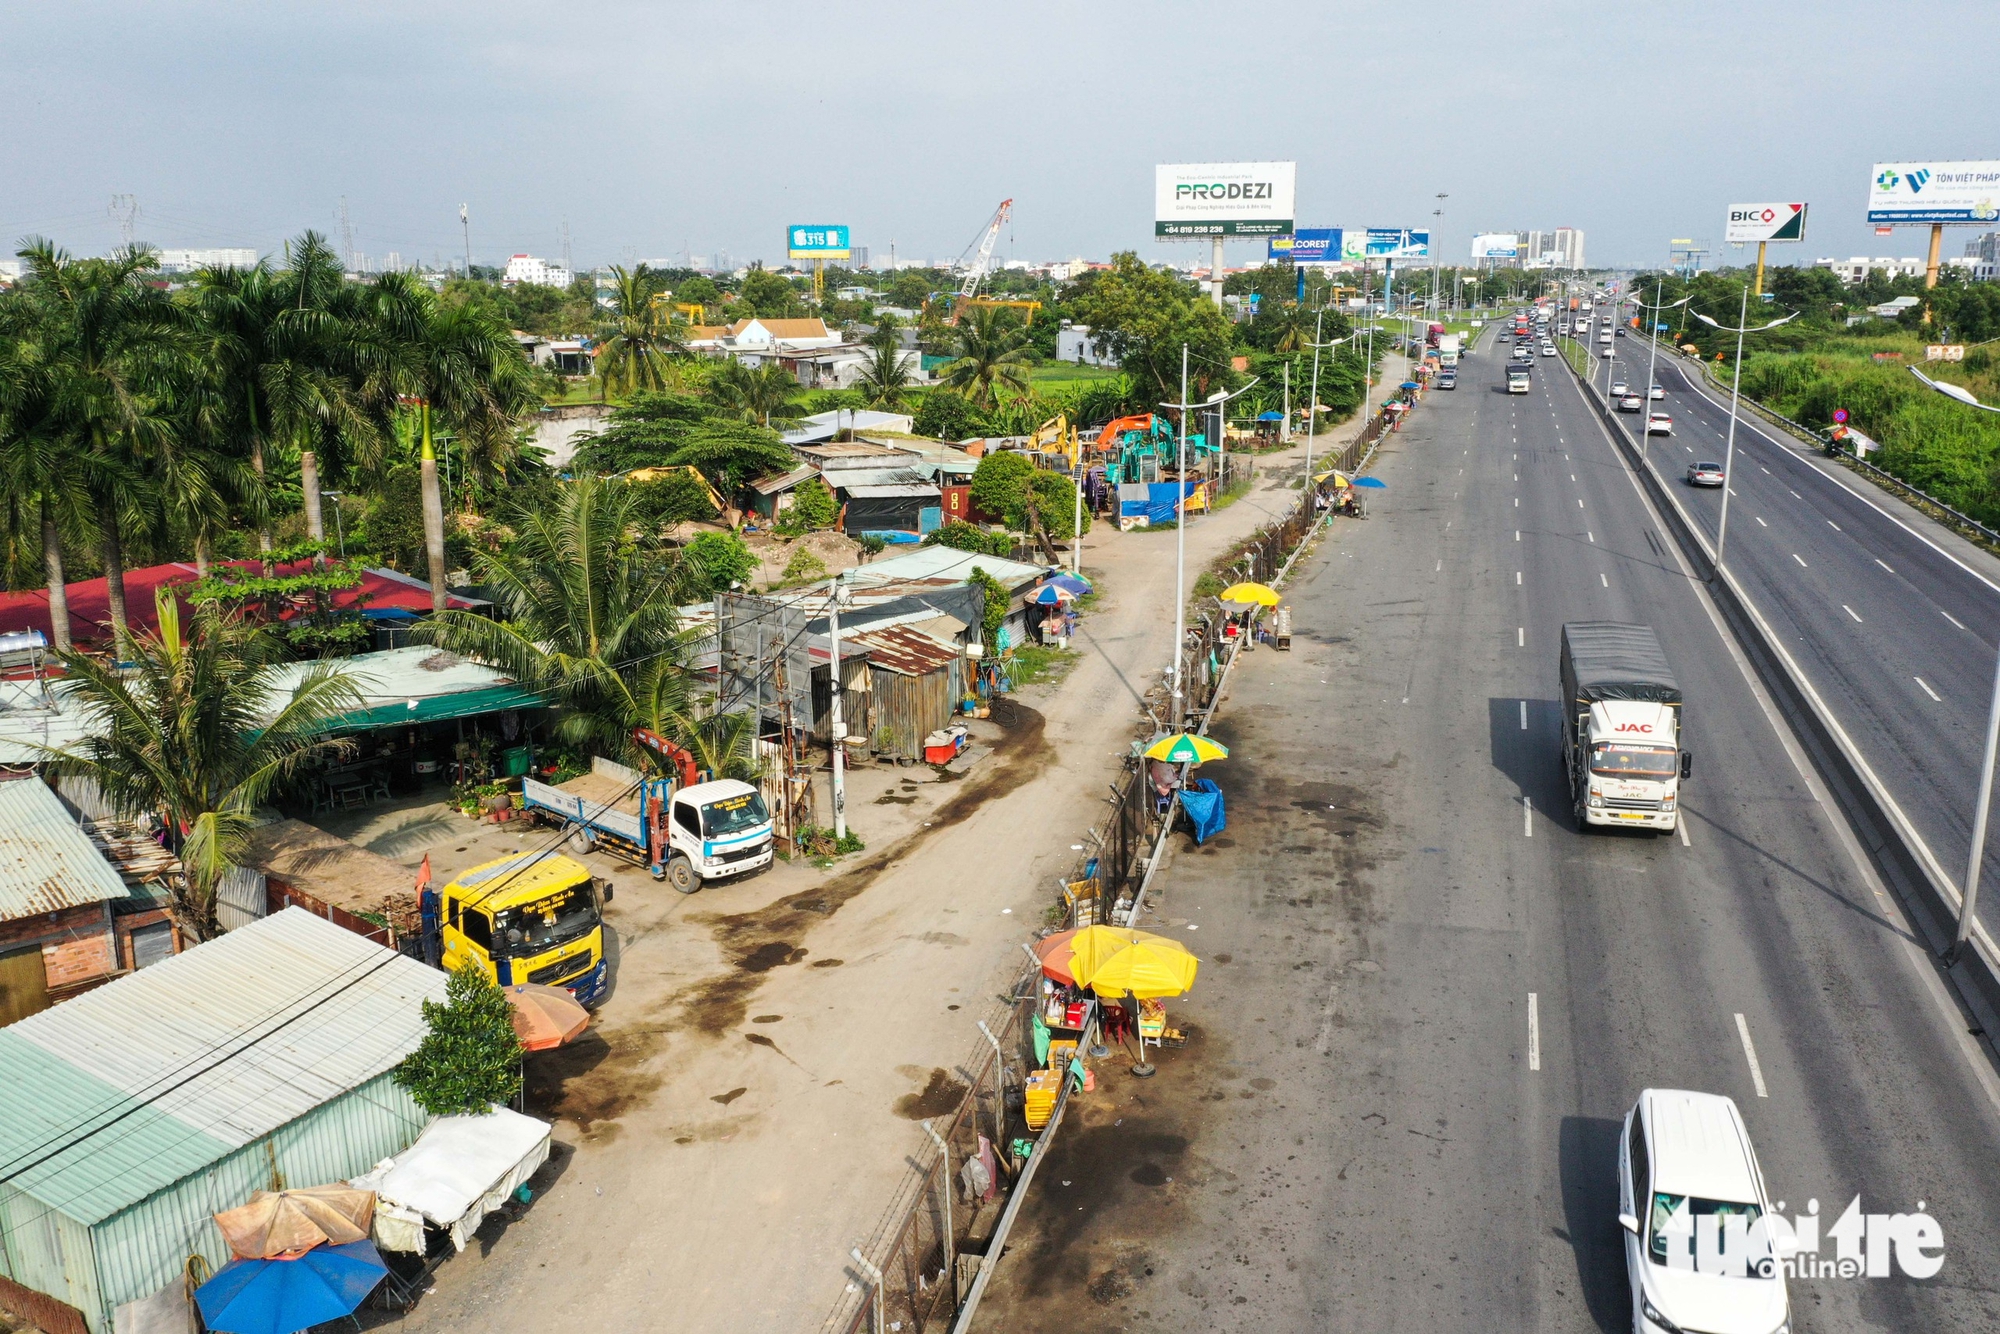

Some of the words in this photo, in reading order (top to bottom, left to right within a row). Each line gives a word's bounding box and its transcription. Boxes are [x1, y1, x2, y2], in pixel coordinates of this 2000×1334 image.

[1176, 182, 1272, 200] PRODEZI
[1164, 226, 1179, 234] +84
[1180, 226, 1193, 234] 819
[807, 235, 825, 246] 315
[1614, 723, 1653, 733] JAC
